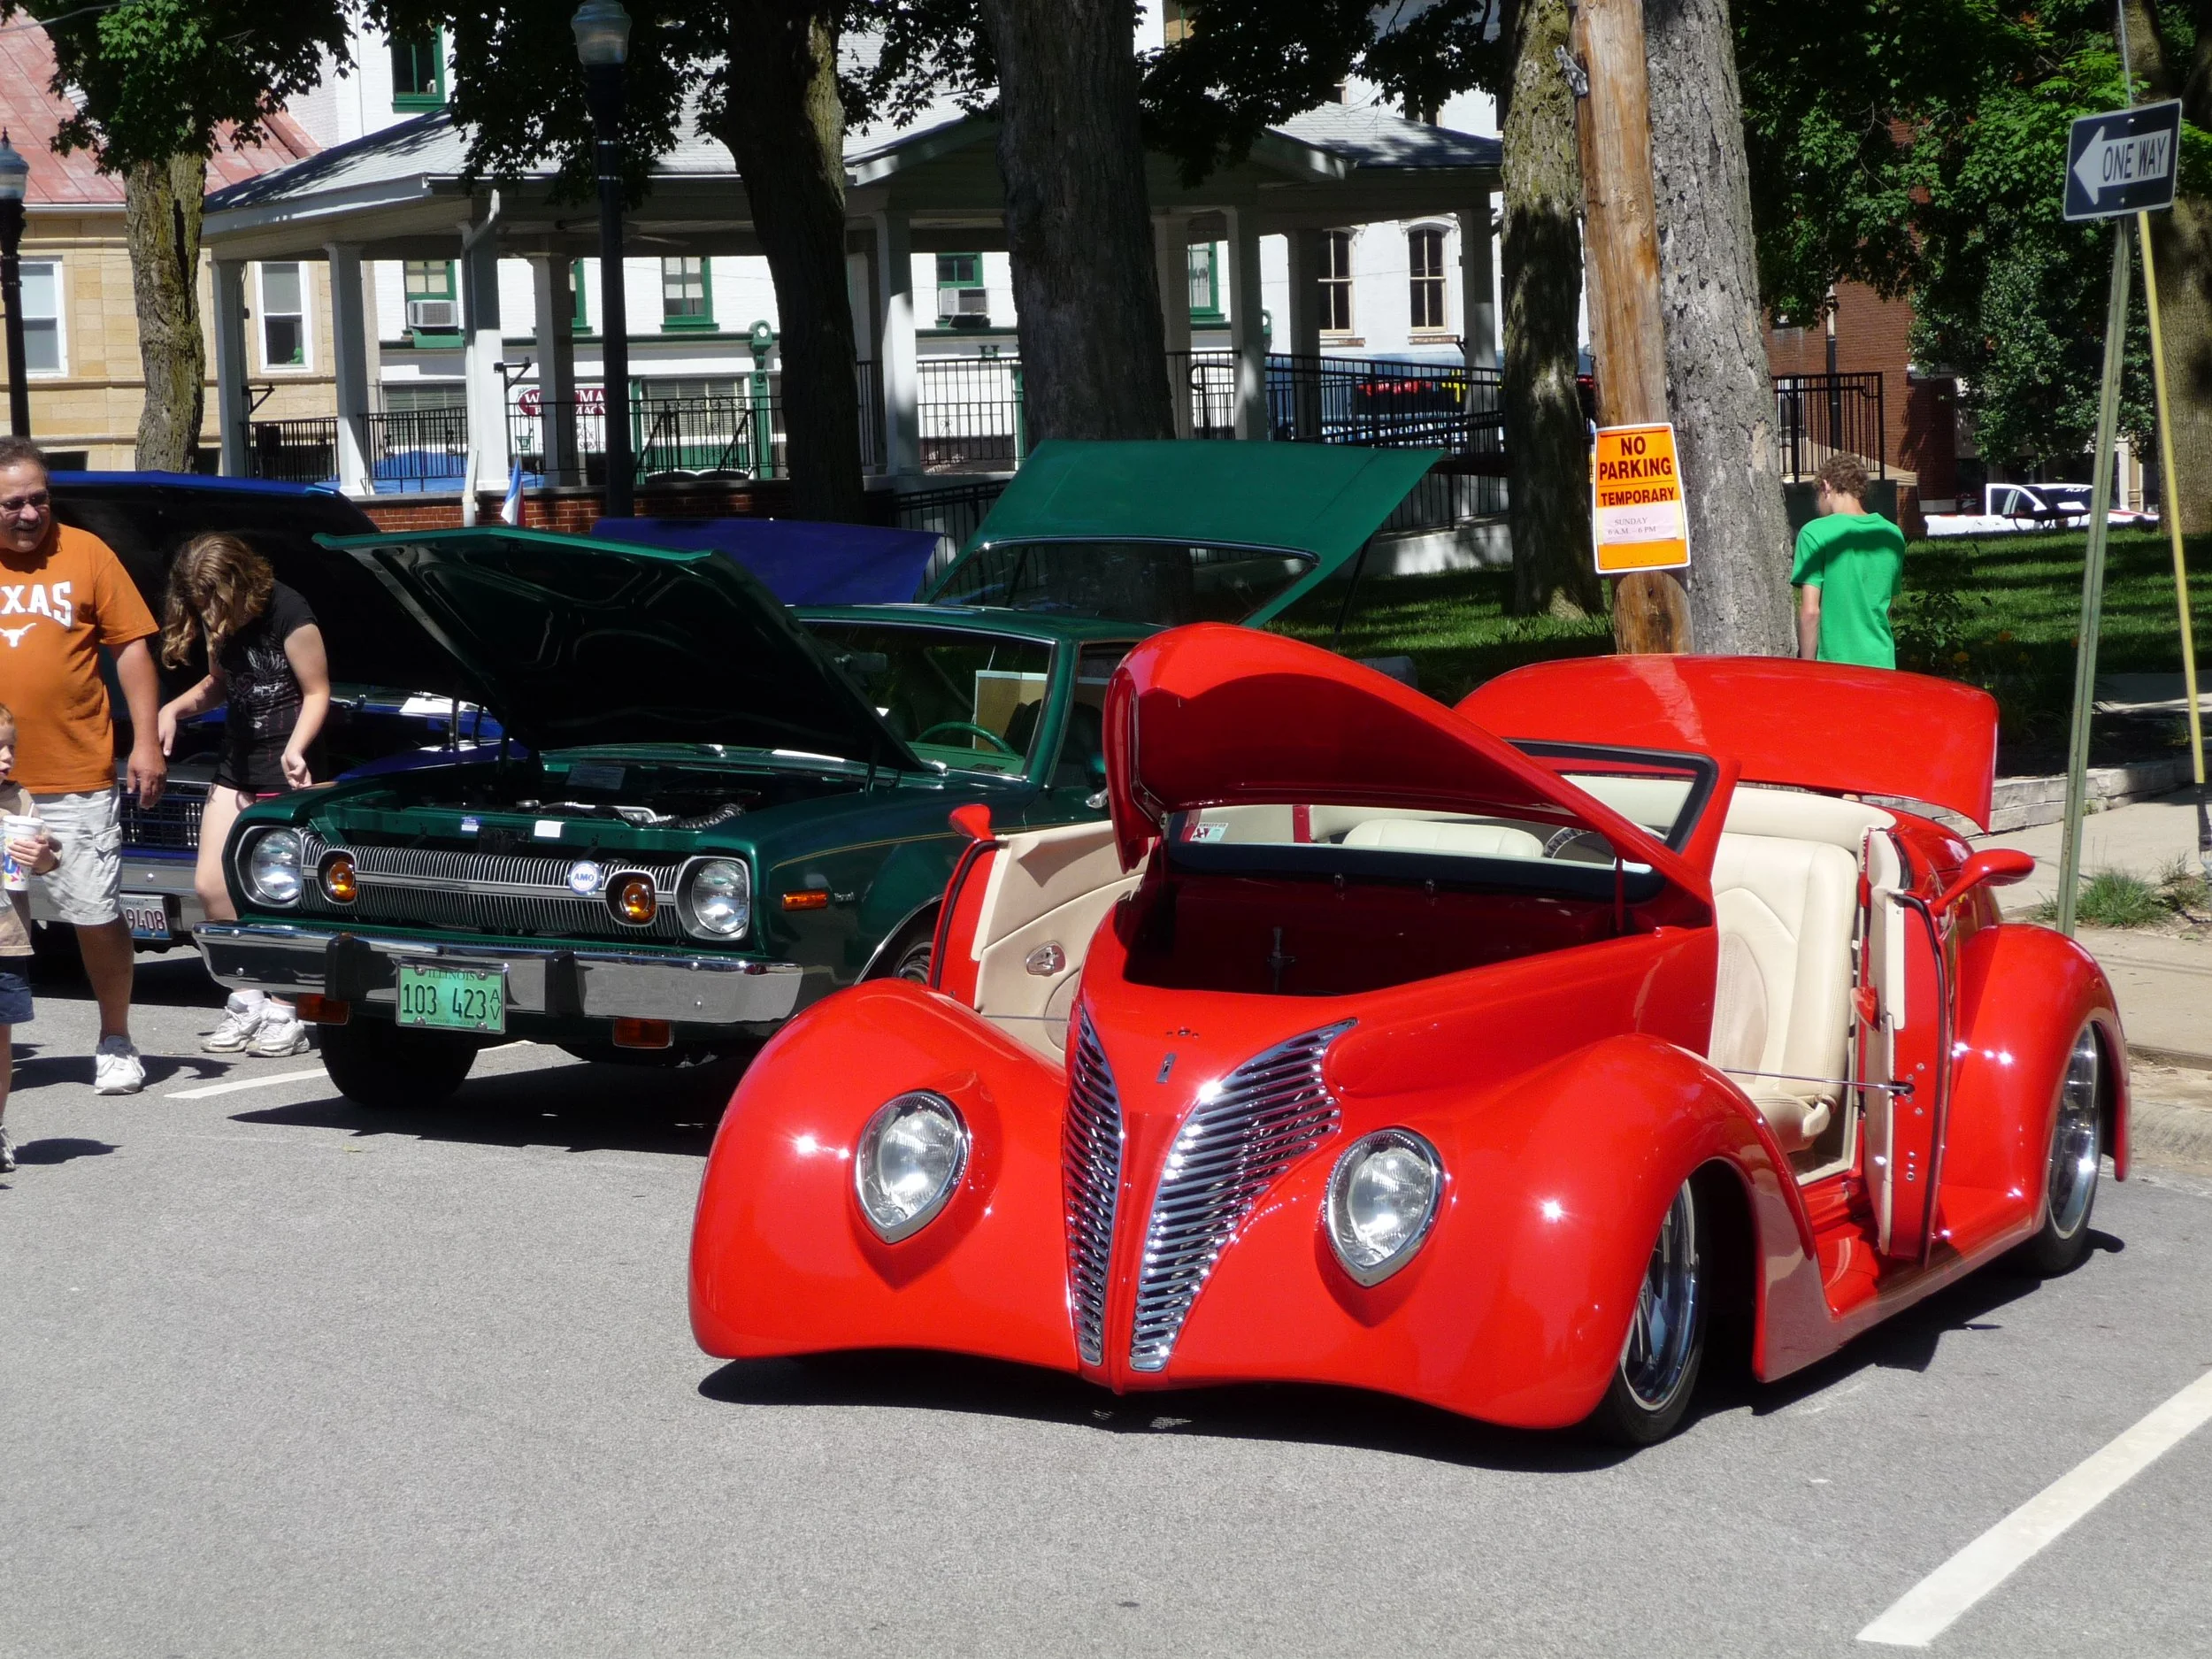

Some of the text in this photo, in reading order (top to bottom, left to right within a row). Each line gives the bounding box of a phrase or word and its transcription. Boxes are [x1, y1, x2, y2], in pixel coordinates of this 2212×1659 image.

[2102, 135, 2168, 182] ONE WAY
[1620, 435, 1647, 457] NO
[1599, 457, 1672, 480] PARKING
[1601, 487, 1675, 507] TEMPORARY
[1614, 517, 1648, 526] SUNDAY
[0, 580, 72, 628] XAS
[126, 907, 165, 932] 9408
[427, 969, 476, 980] ILLINOIS
[403, 983, 438, 1016] 103
[452, 987, 487, 1020] 423
